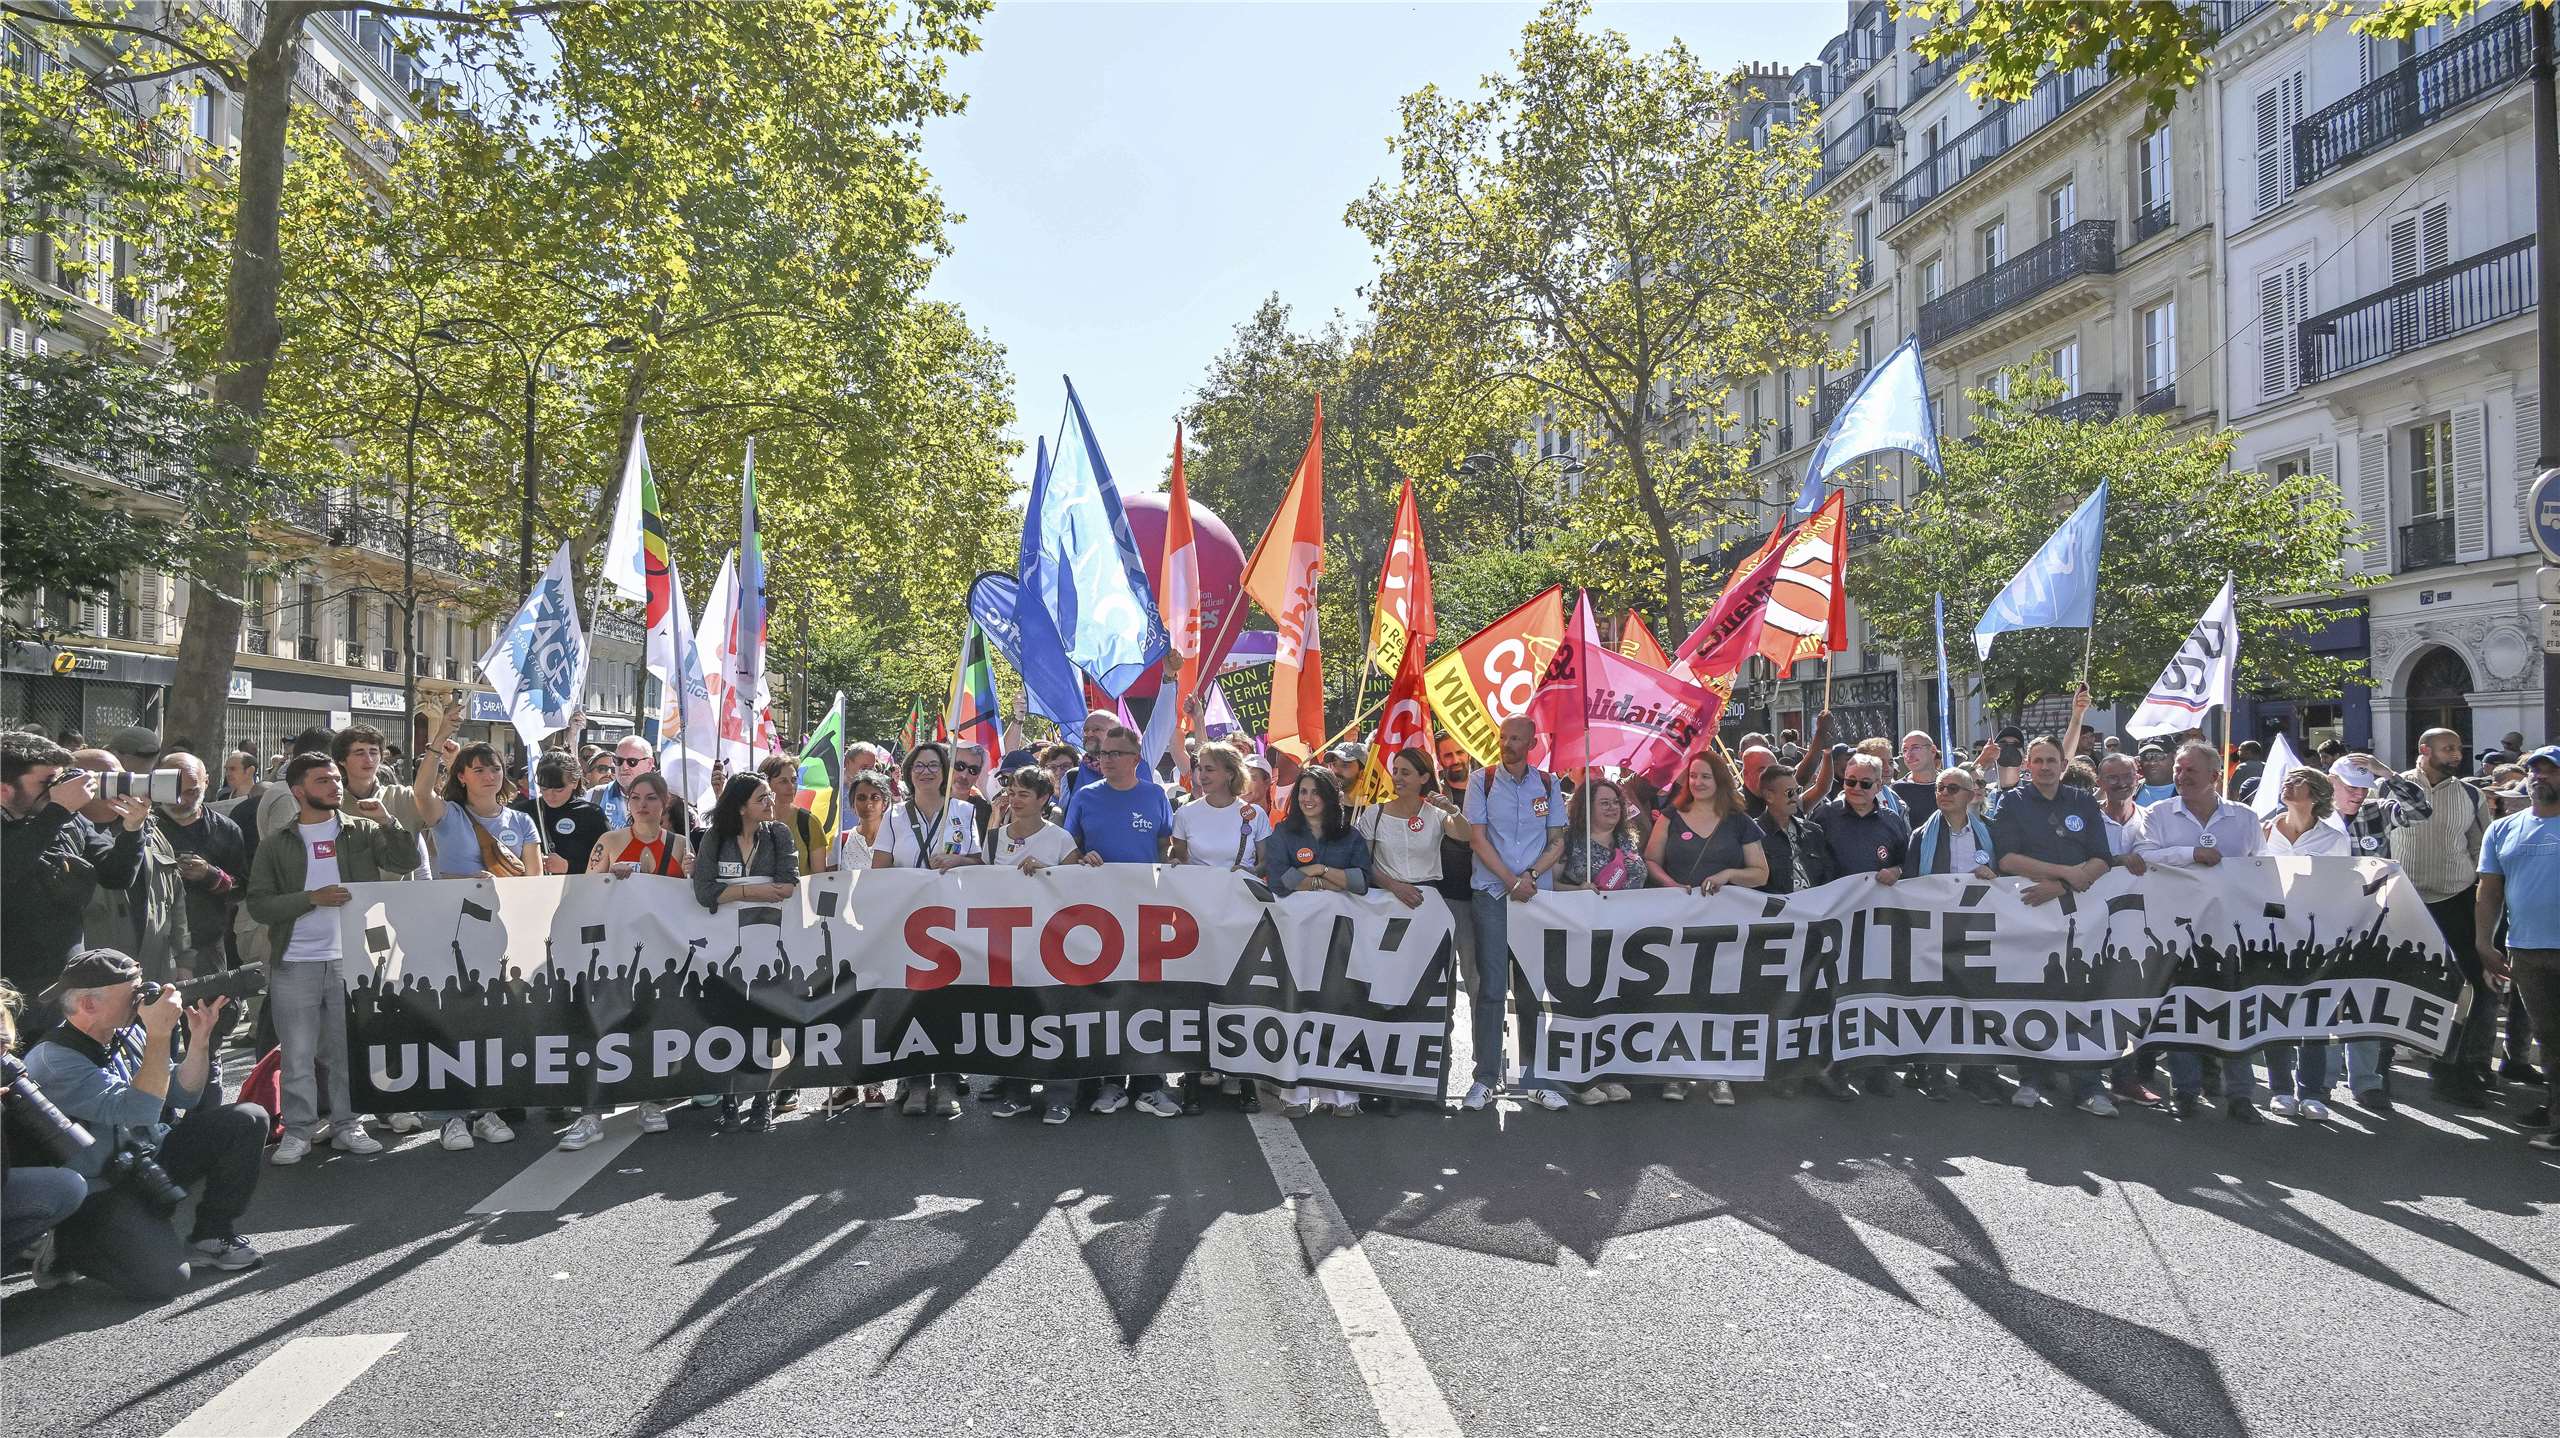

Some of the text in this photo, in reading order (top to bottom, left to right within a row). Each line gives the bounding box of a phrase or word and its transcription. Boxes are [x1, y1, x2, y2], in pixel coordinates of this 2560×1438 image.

[1220, 668, 1258, 689] NON
[1225, 681, 1273, 703] FERME
[1232, 699, 1271, 720] STELL
[1434, 666, 1501, 765] YVELIN
[1533, 802, 1549, 812] cgt
[1410, 818, 1424, 830] cgt
[903, 904, 1200, 991] STOP
[1224, 878, 1299, 995] À
[653, 1023, 843, 1078] POUR
[861, 1017, 939, 1065] LA
[954, 1009, 1201, 1060] JUSTICE
[1217, 1014, 1444, 1078] SOCIALE
[1547, 1020, 1760, 1073] FISCALE
[1776, 1014, 1829, 1061] ET
[1838, 986, 2445, 1052] ENVIRONNEMENTALE
